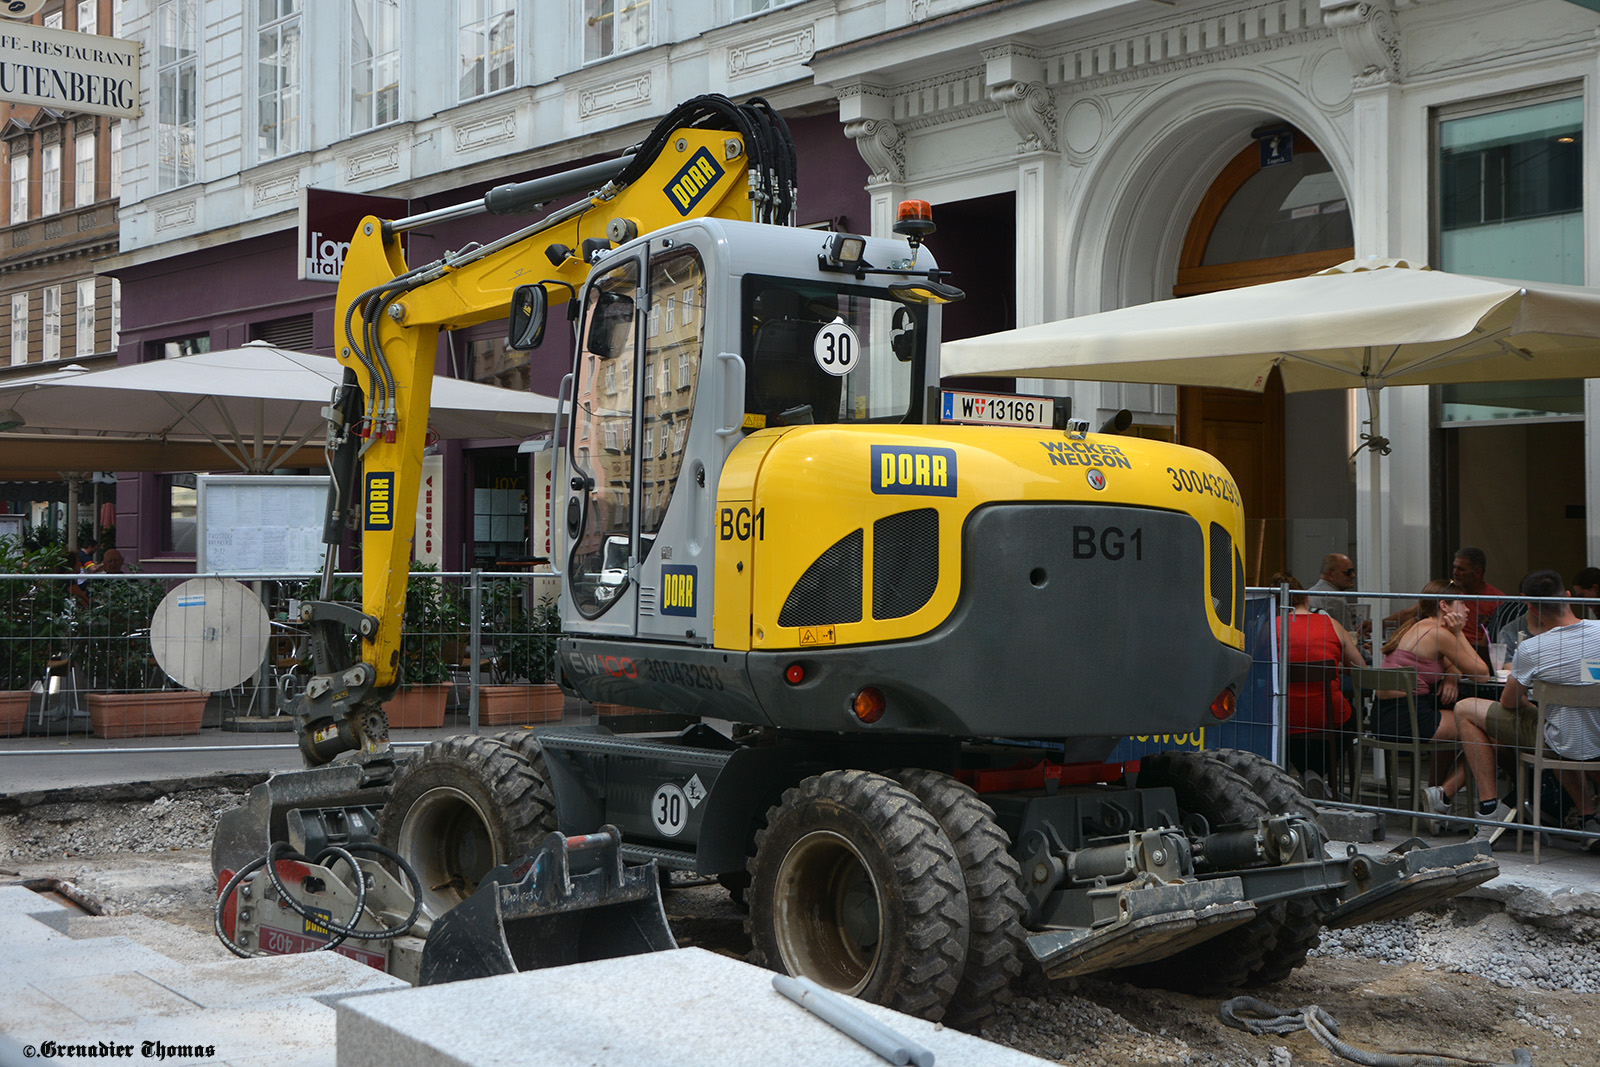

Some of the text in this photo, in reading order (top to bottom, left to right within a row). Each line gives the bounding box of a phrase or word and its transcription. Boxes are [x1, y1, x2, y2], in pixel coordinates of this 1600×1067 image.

[671, 156, 716, 209] PORR
[822, 332, 851, 366] 30
[962, 397, 974, 417] W
[1039, 441, 1126, 457] WACKER
[1048, 452, 1132, 470] NEUSON
[881, 453, 948, 488] PORR
[1166, 467, 1240, 507] 30043293
[369, 478, 390, 525] PORR
[720, 507, 765, 541] BG1
[1072, 525, 1143, 561] BG1
[664, 573, 694, 609] PORR
[644, 657, 724, 692] 30043293
[657, 792, 680, 827] 30
